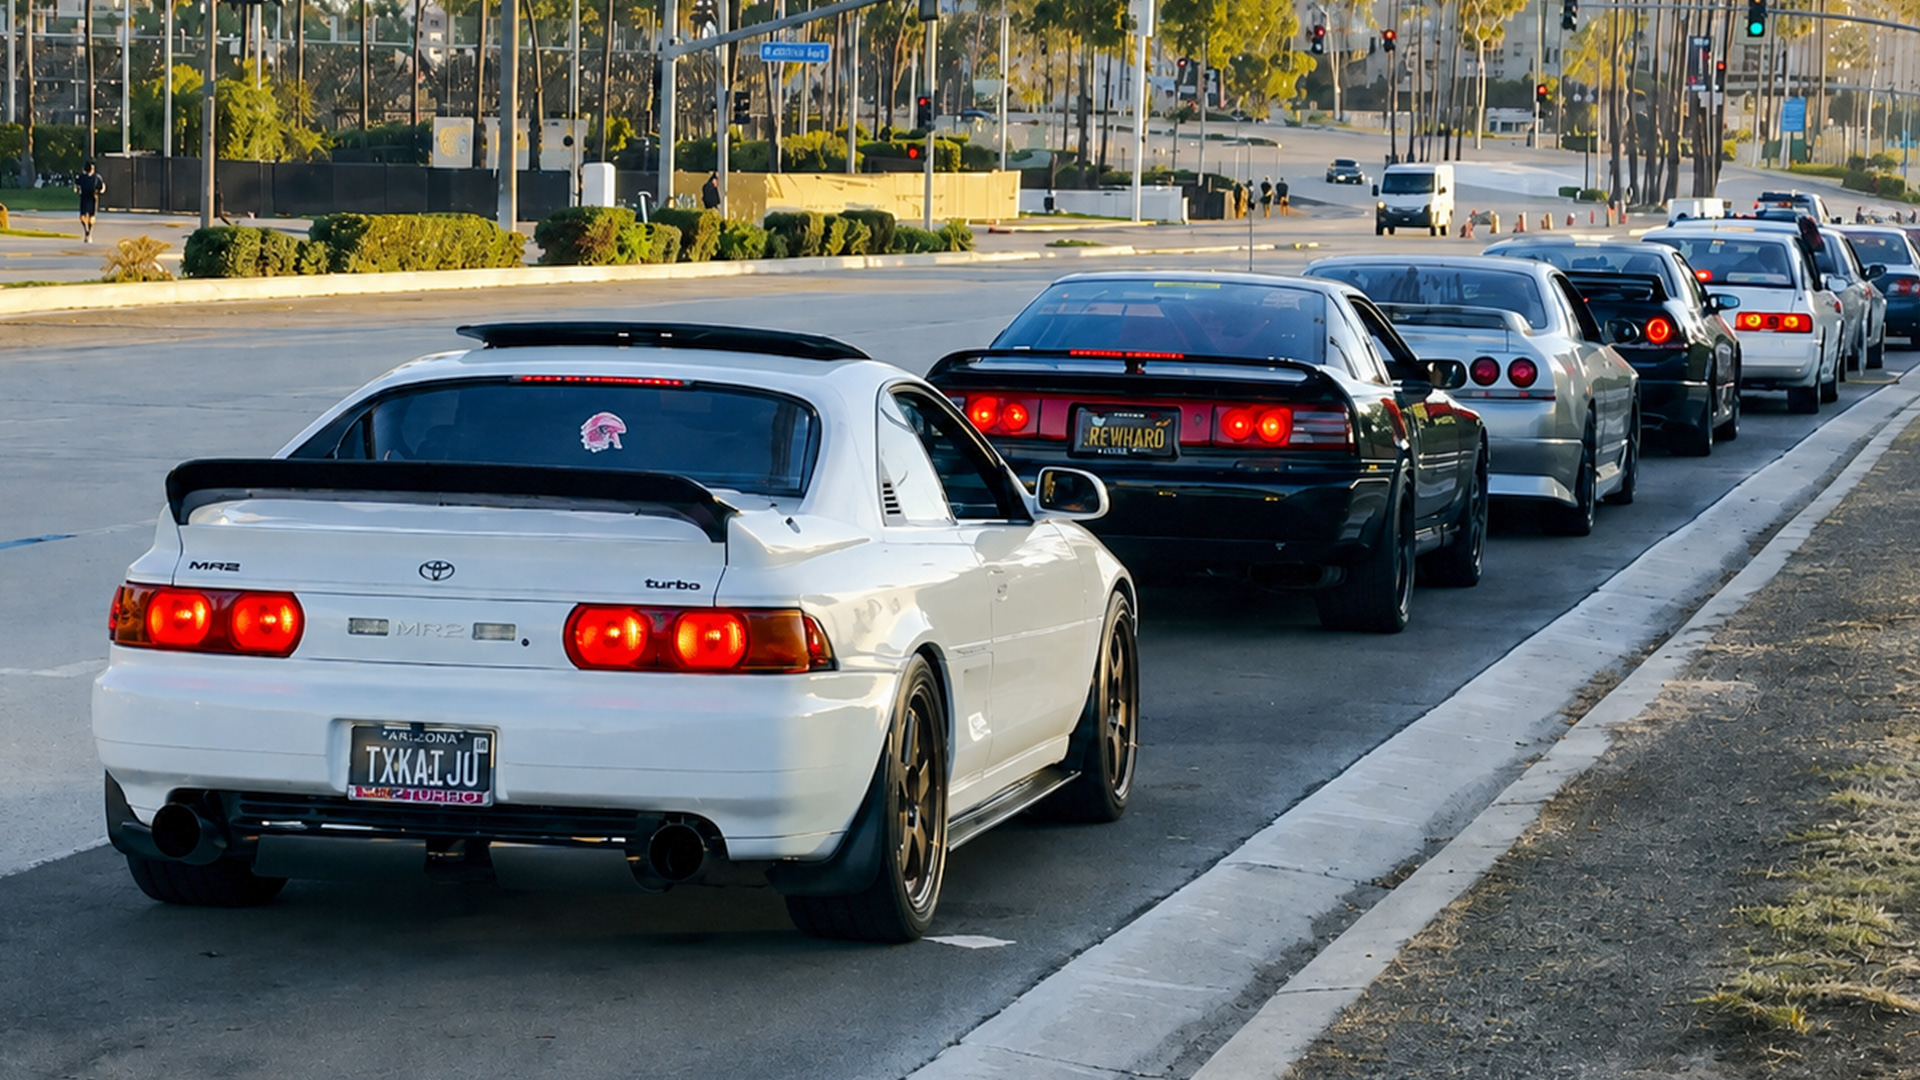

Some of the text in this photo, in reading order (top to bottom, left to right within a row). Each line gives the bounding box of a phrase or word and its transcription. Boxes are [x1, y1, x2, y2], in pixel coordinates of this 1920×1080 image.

[188, 561, 241, 572] MR2
[644, 578, 701, 591] turbo
[396, 619, 465, 639] MR2
[365, 745, 479, 787] TXKAIJU
